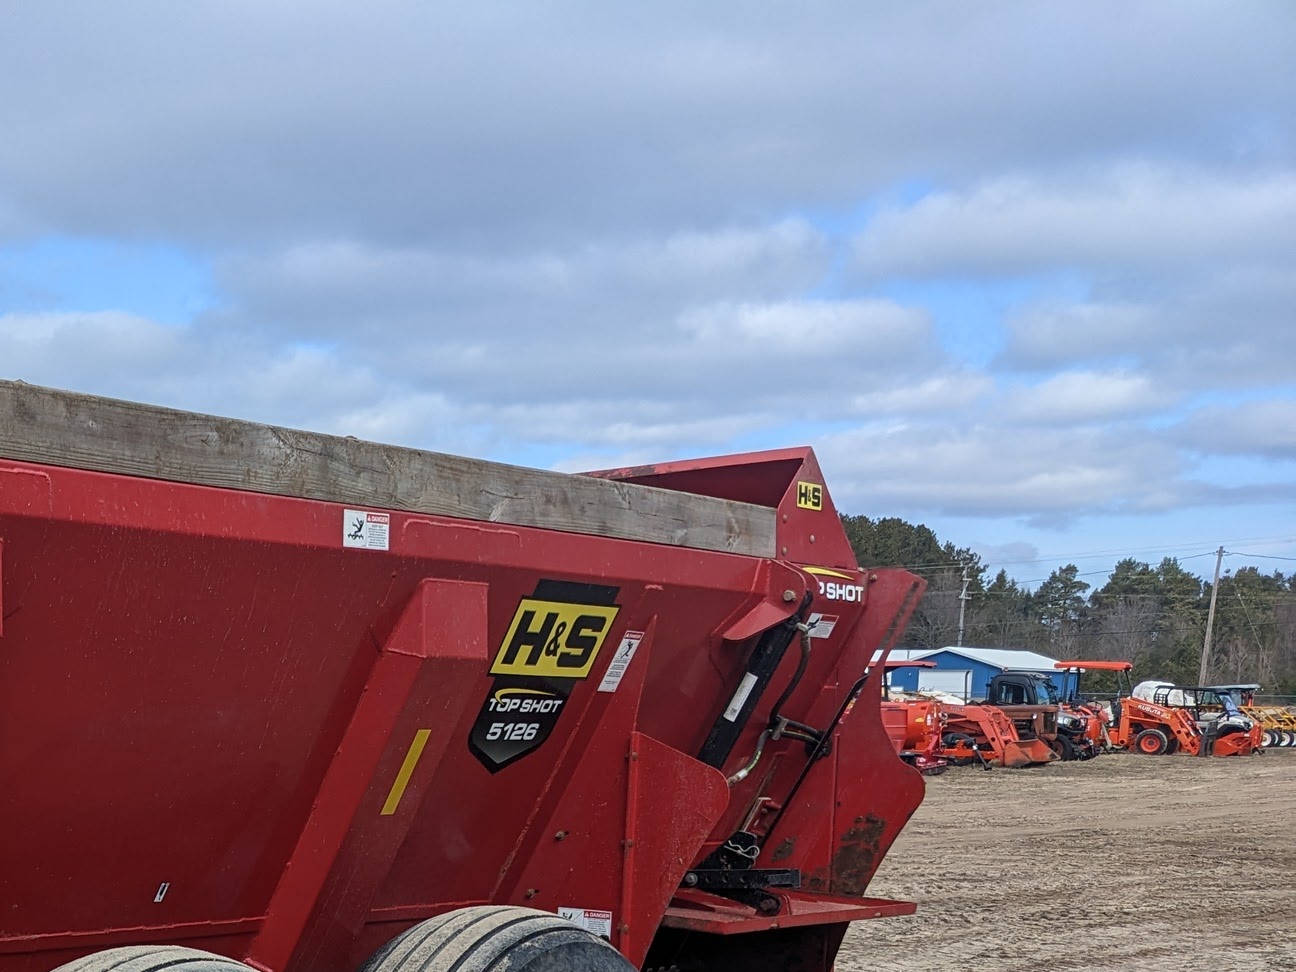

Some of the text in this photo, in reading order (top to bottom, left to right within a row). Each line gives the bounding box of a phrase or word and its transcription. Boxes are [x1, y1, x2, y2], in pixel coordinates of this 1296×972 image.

[798, 484, 821, 508] H&S
[826, 584, 864, 602] SHOT
[501, 610, 607, 668] H&S
[489, 698, 563, 713] TOP SHOT
[486, 722, 540, 740] 5126
